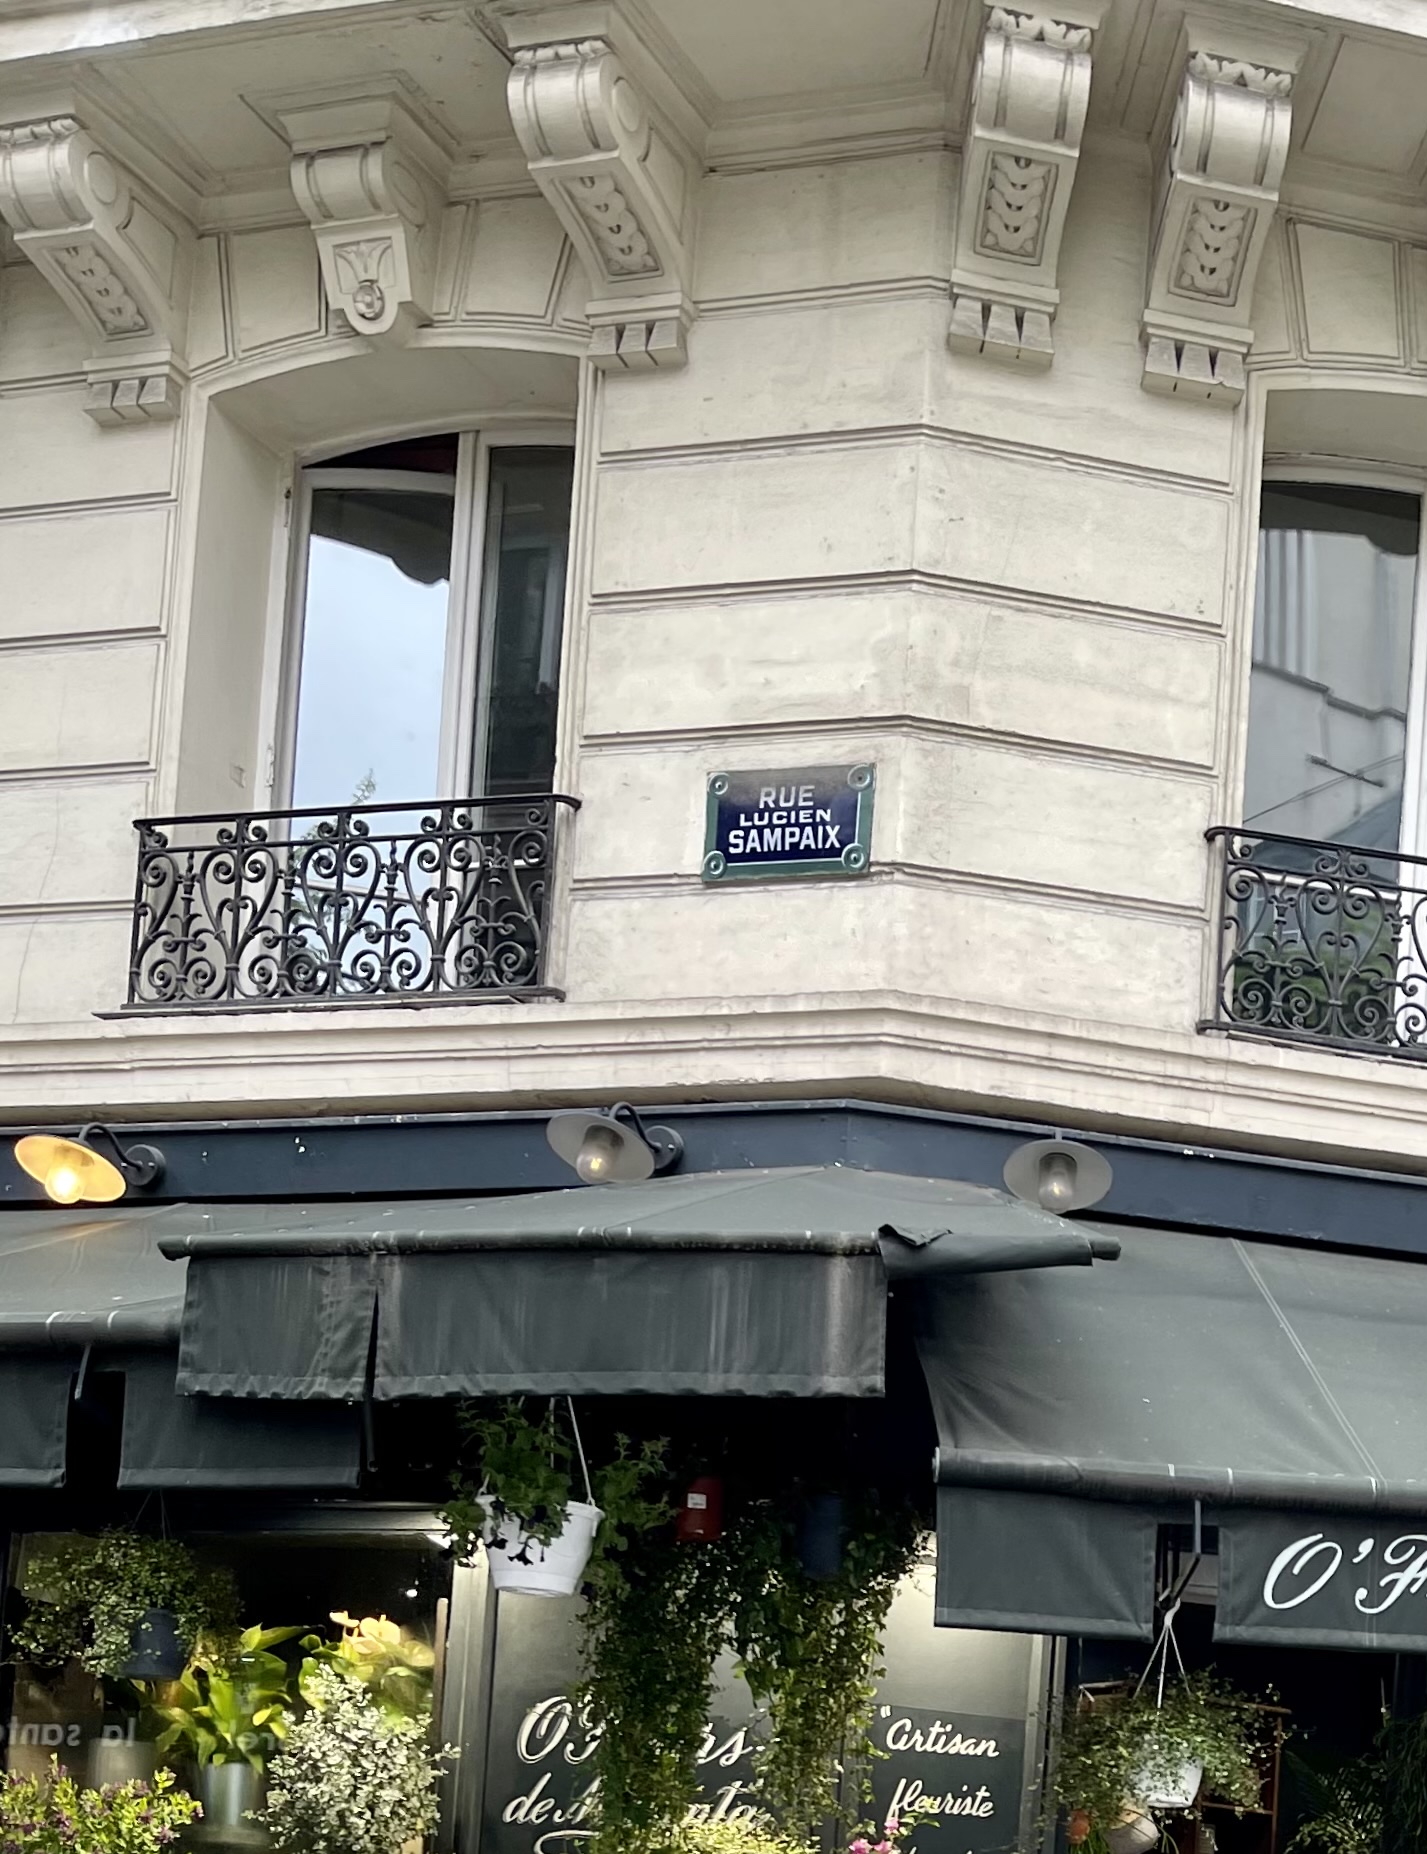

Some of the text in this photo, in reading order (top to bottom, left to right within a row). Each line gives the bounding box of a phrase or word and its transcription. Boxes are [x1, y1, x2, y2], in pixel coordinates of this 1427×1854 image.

[759, 785, 815, 808] RUE
[739, 809, 832, 827] LUCIEN
[728, 825, 841, 854] SAMPAIX
[502, 1772, 555, 1825] de
[886, 1778, 995, 1824] fleuriste
